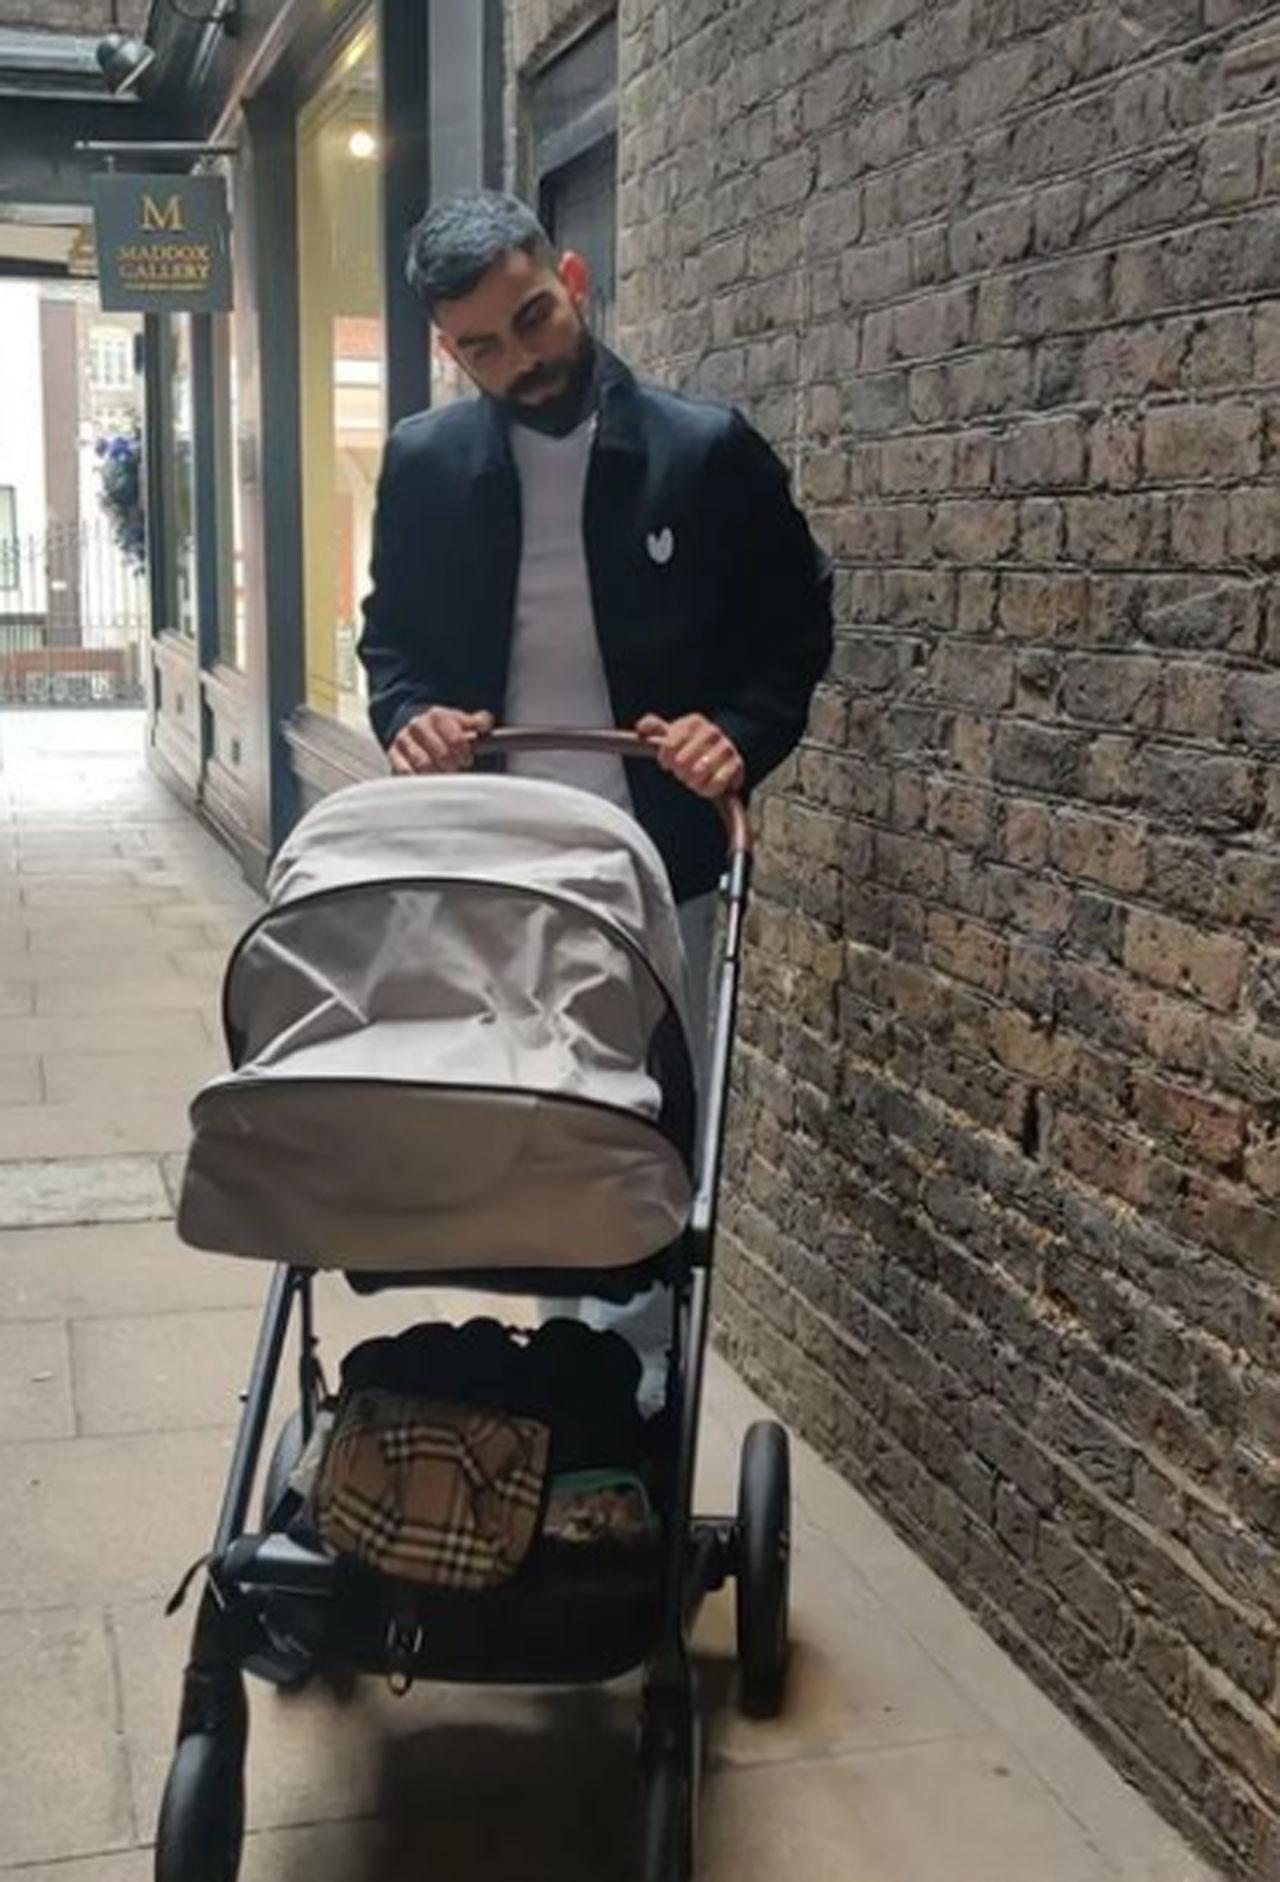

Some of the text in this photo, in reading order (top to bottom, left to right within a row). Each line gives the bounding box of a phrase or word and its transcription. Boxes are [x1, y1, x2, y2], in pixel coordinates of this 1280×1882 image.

[140, 194, 184, 231] M
[118, 244, 209, 261] MADDOX
[118, 263, 209, 279] GALLERY
